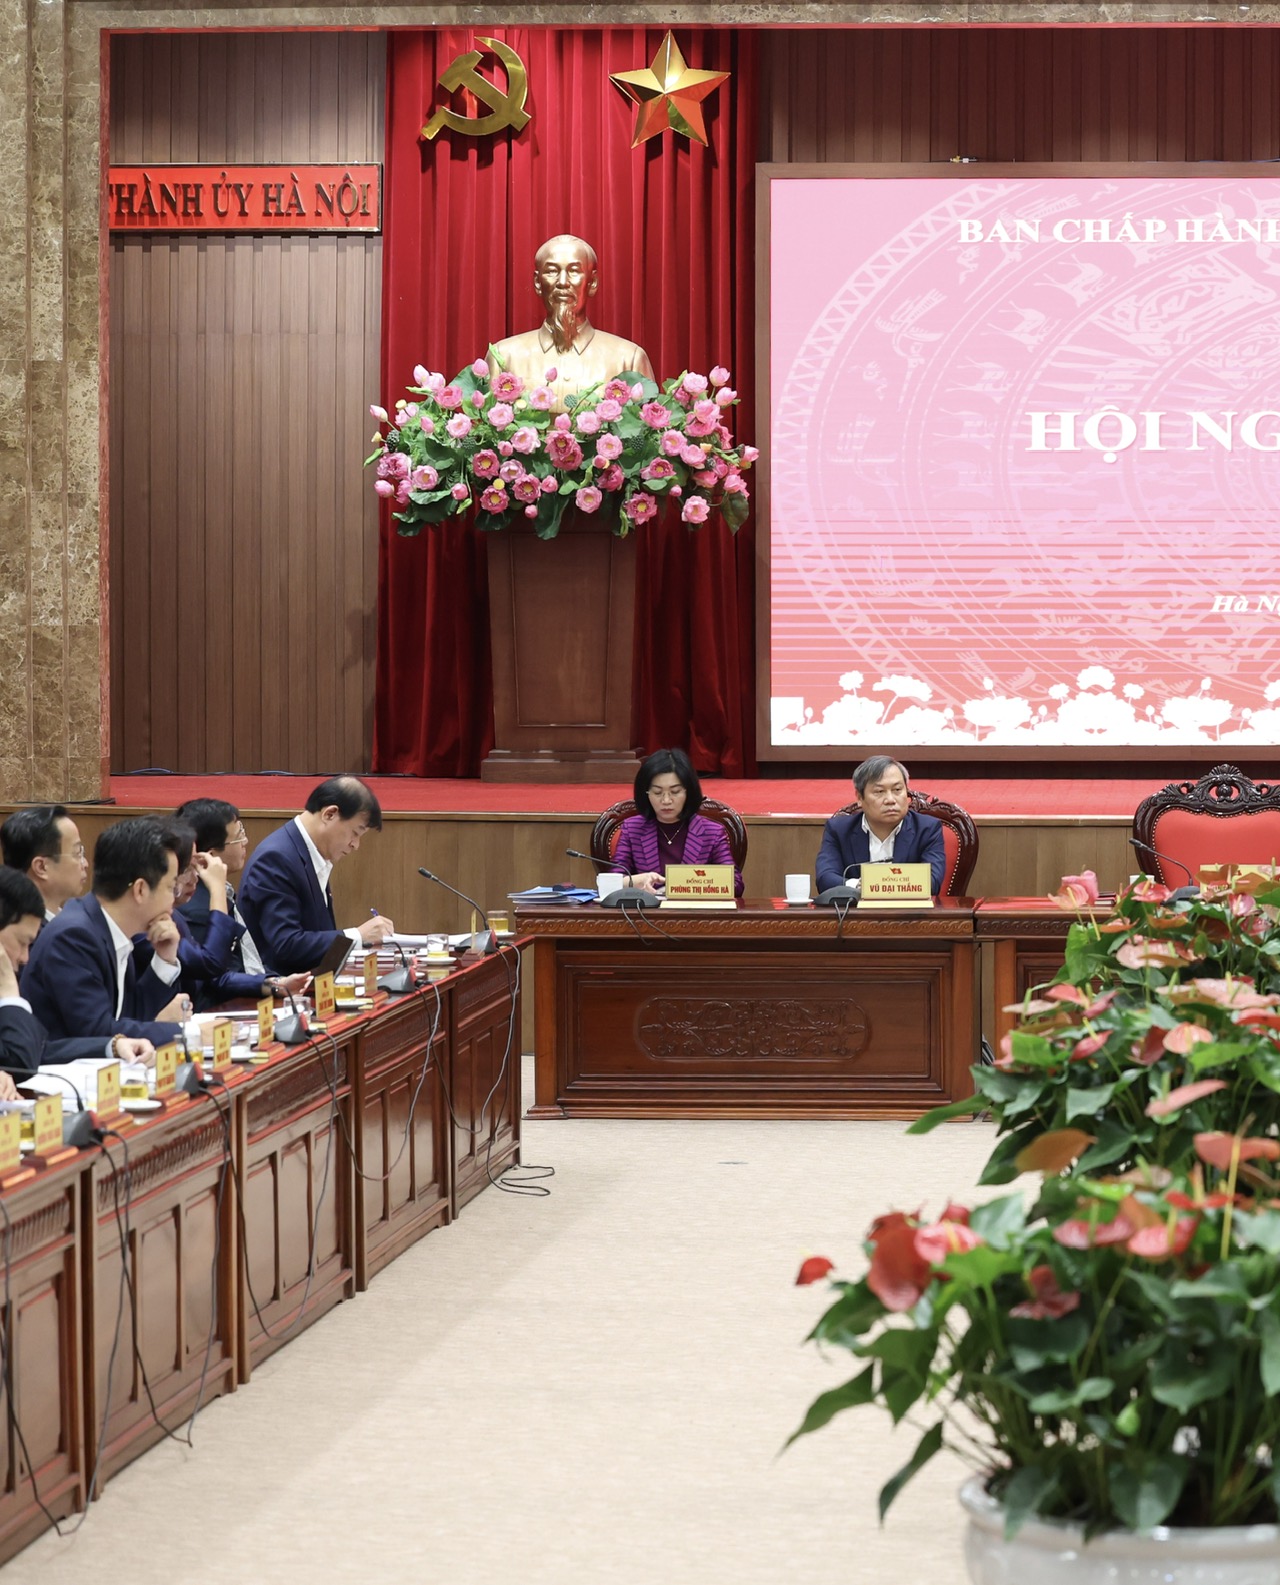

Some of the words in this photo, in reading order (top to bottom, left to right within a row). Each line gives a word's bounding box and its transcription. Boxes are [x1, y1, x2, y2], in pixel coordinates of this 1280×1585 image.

[212, 171, 253, 217] ỦY
[263, 172, 307, 217] HÀ
[315, 172, 371, 226] NỘI
[957, 219, 1042, 244] BAN
[1053, 212, 1167, 244] CHẤP
[1024, 405, 1167, 464] HỘI
[1209, 595, 1249, 613] Hà
[670, 885, 691, 893] PHÙNG
[692, 886, 702, 895] THỊ
[720, 885, 729, 893] HÀ
[869, 883, 880, 892] VŨ
[881, 884, 895, 894] ĐẠI
[897, 882, 923, 892] THẮNG
